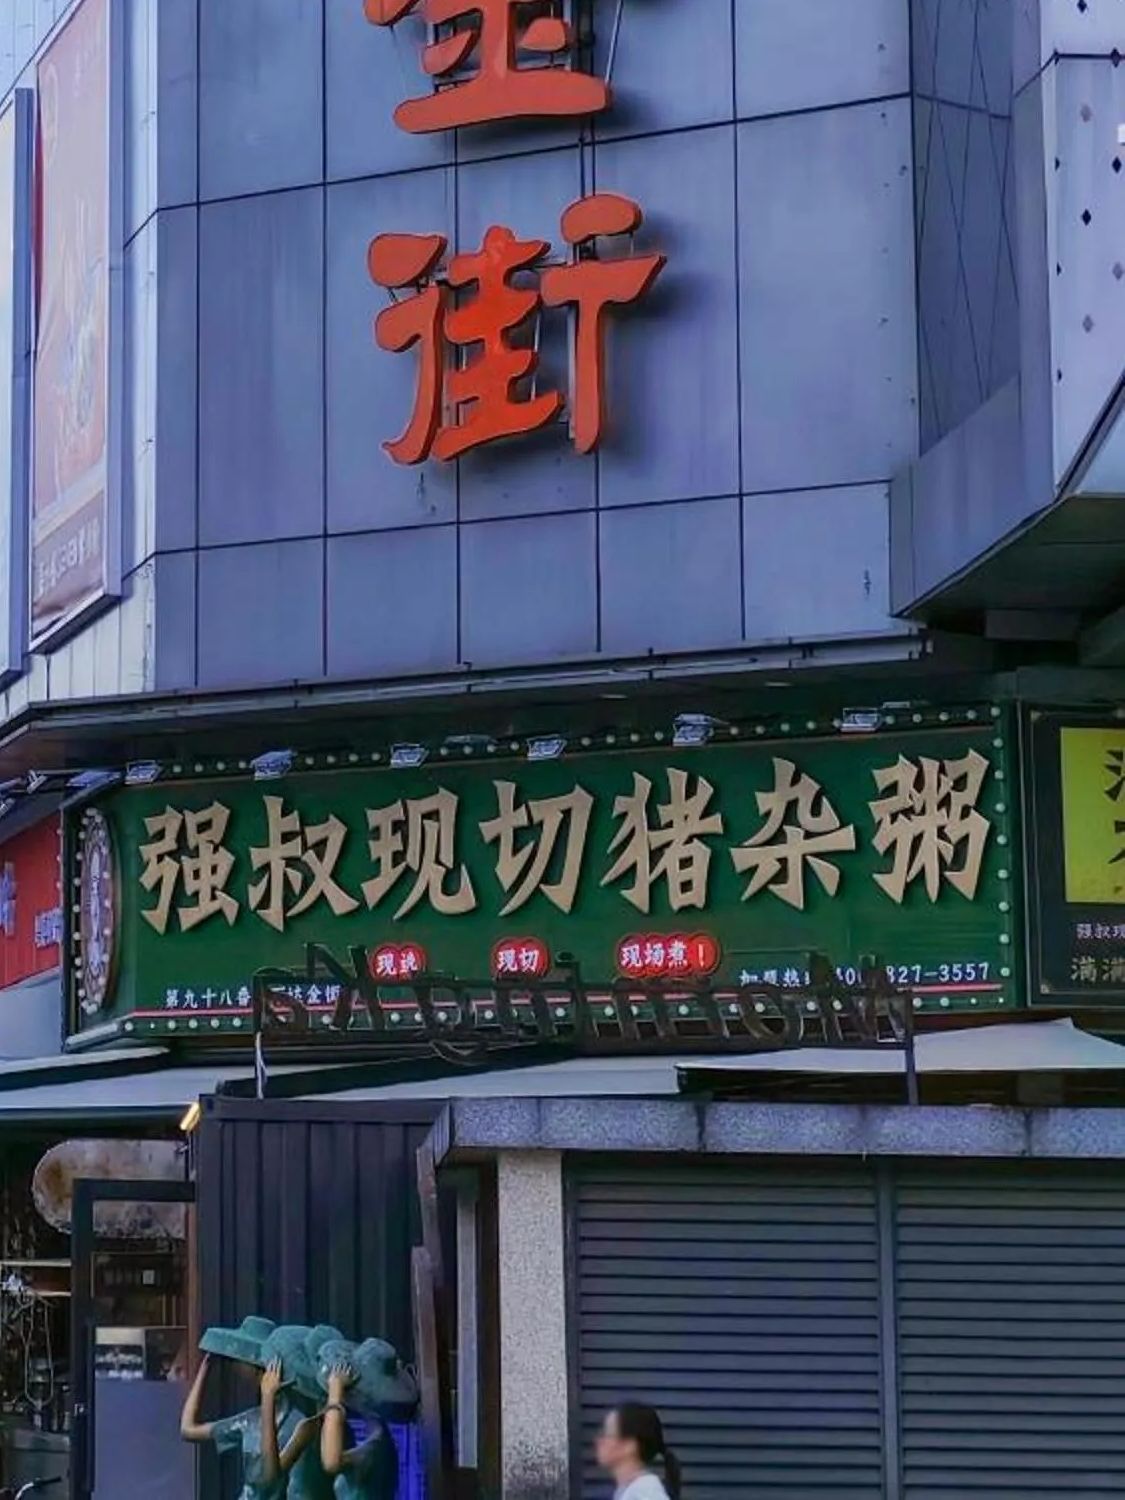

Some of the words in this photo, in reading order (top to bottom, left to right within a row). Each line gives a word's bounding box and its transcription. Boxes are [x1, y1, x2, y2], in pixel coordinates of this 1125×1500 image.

[138, 748, 991, 936] 强叔现切猪杂粥
[497, 947, 539, 973] 现切
